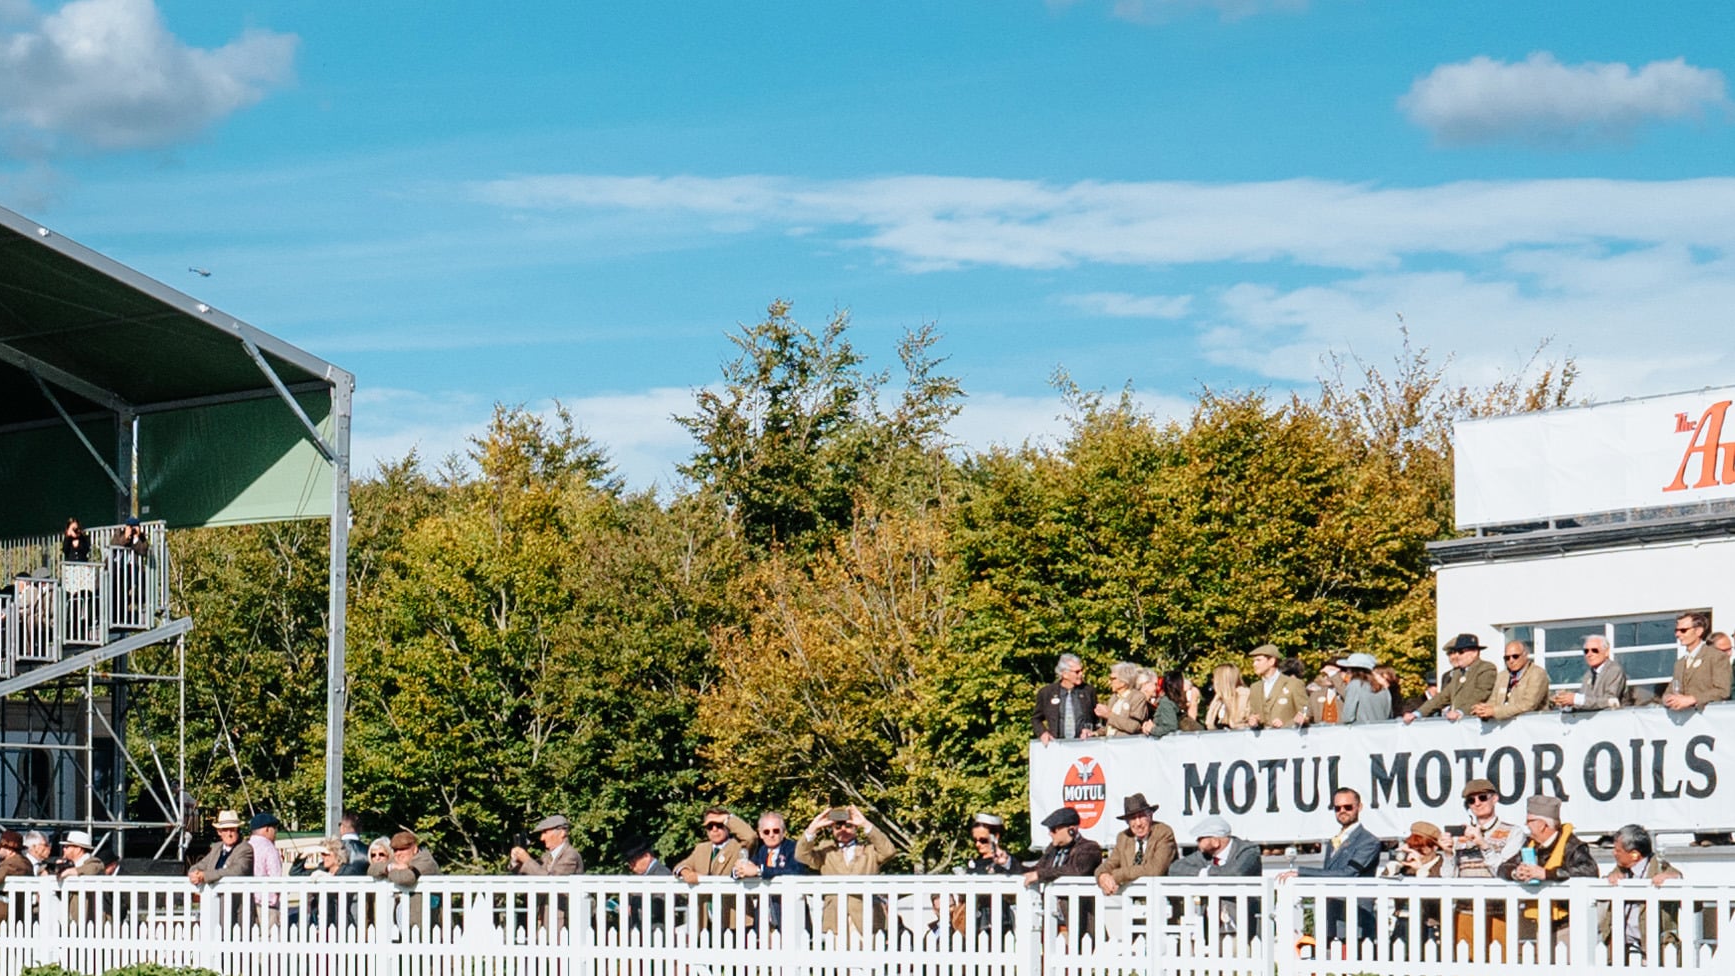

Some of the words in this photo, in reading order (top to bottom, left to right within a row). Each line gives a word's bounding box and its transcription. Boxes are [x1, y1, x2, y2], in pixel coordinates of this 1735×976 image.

[1674, 412, 1697, 434] The
[1182, 755, 1341, 815] MOTUL
[1370, 743, 1569, 809] MOTOR
[1583, 734, 1718, 801] OILS
[1064, 785, 1105, 801] MOTUL
